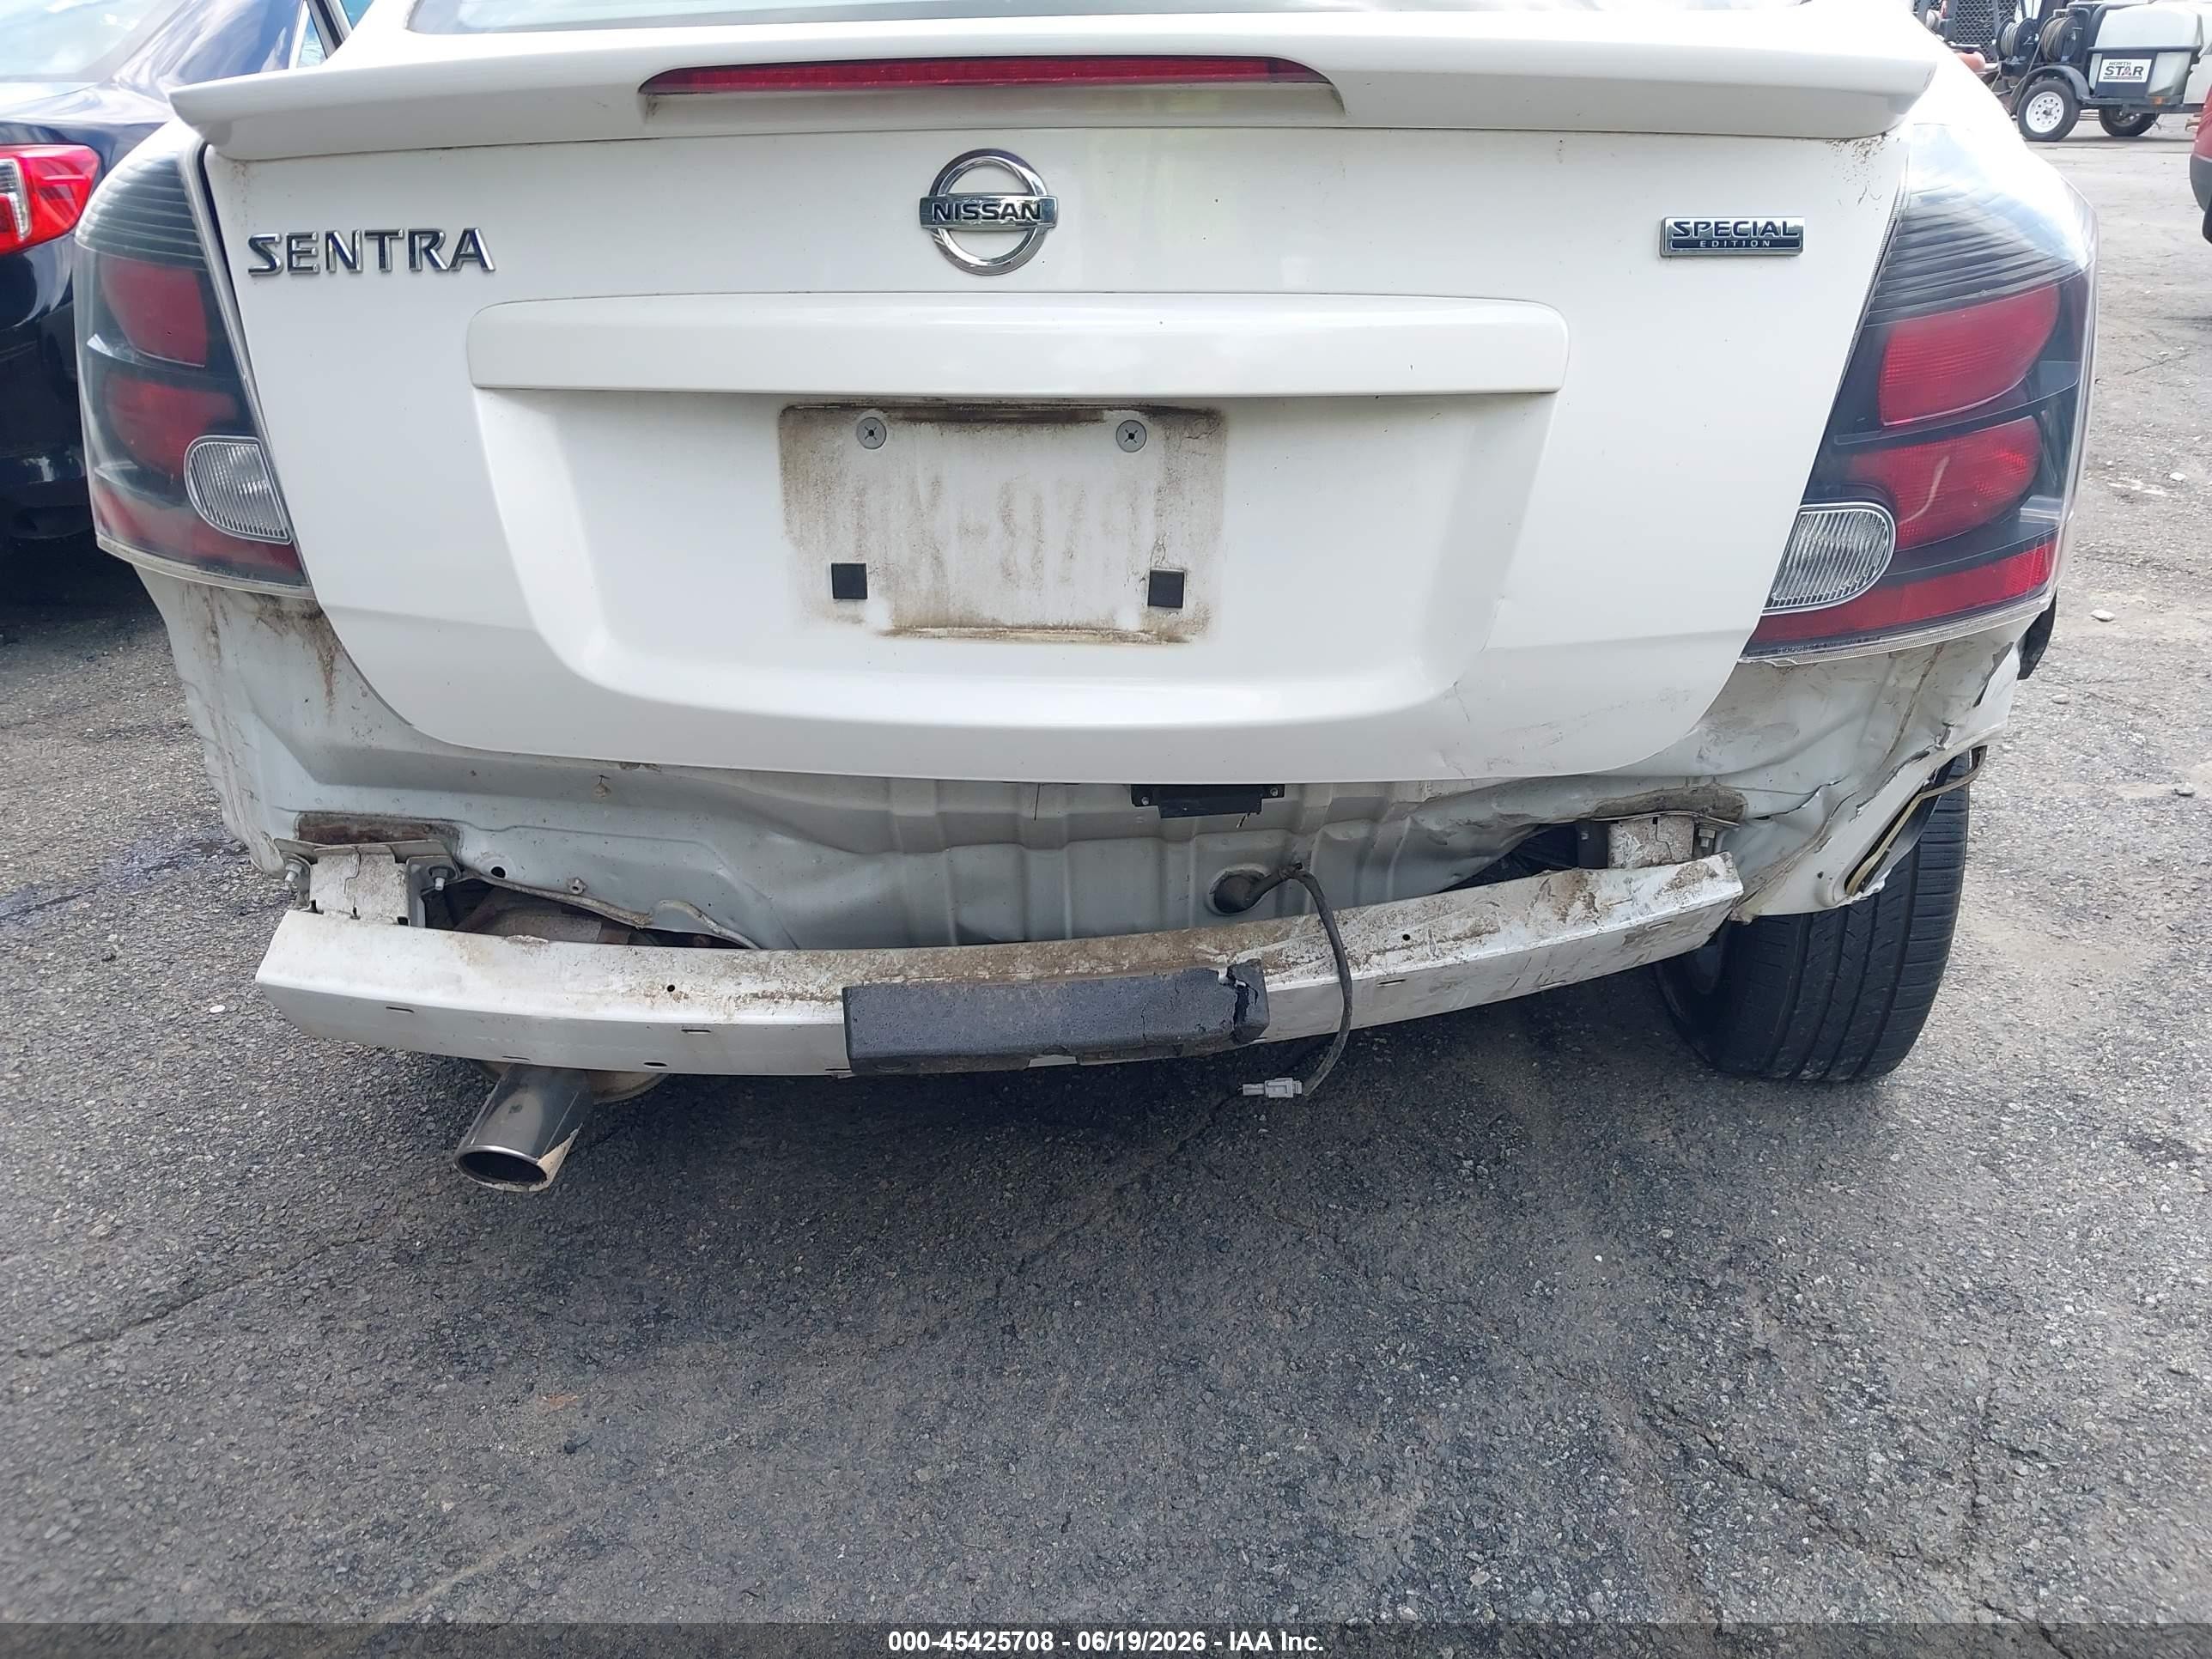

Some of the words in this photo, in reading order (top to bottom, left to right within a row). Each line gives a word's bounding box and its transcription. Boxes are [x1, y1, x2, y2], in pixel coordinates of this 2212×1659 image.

[2104, 65, 2144, 76] STAR
[932, 202, 1042, 221] NISSAN
[1671, 220, 1800, 238] SPECIAL
[247, 227, 495, 276] SENTRA
[1699, 240, 1771, 248] EDITION
